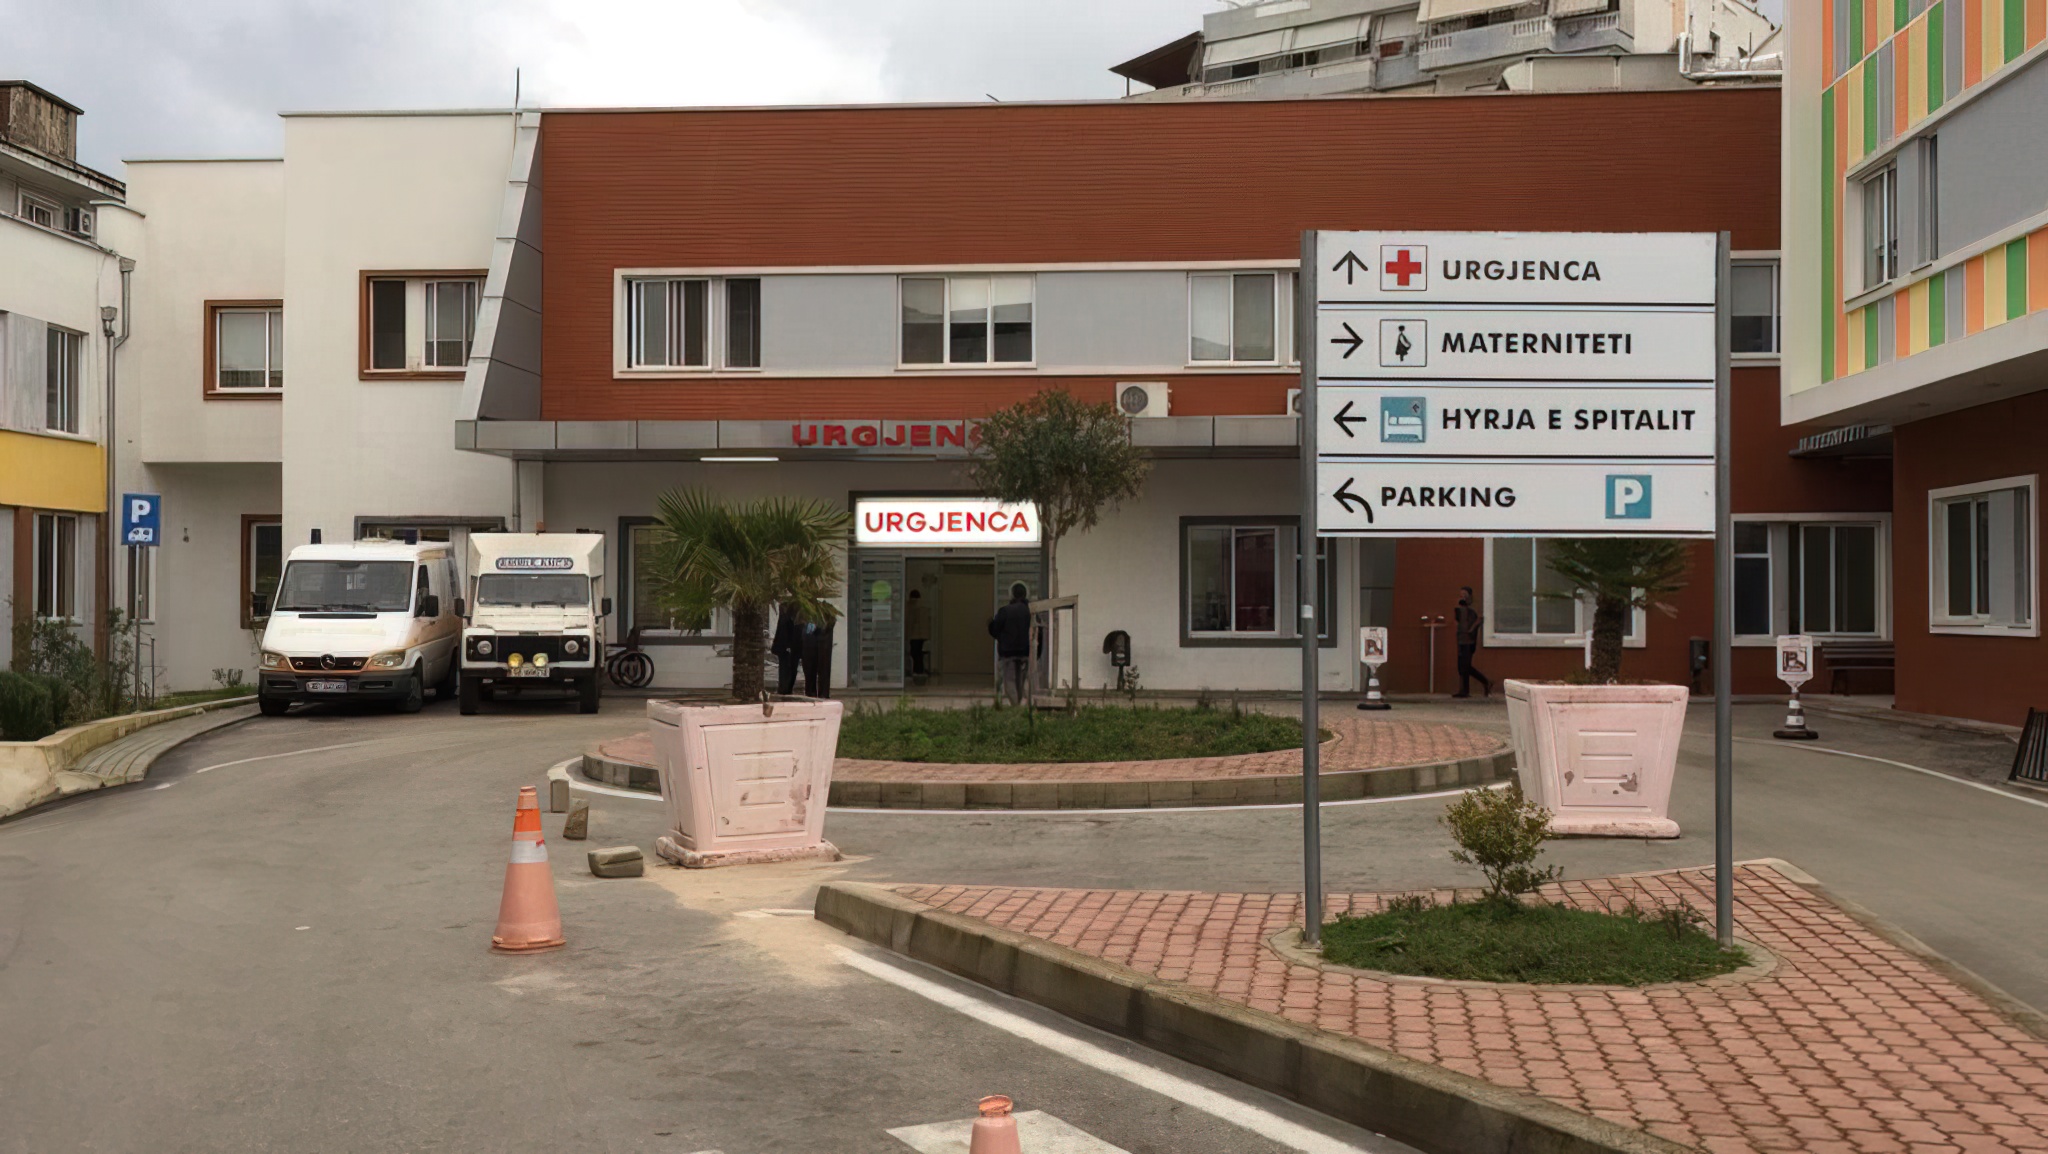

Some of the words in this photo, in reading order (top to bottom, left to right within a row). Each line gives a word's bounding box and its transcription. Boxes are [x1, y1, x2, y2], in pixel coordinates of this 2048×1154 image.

[1442, 260, 1601, 282] URGJENCA
[1441, 332, 1632, 355] MATERNITETI
[1442, 408, 1535, 430] HYRJA
[1549, 409, 1562, 430] E
[1574, 408, 1696, 431] SPITALIT
[1381, 486, 1516, 508] PARKING
[1614, 478, 1643, 516] P
[131, 499, 151, 523] P
[865, 511, 1030, 533] URGJENCA
